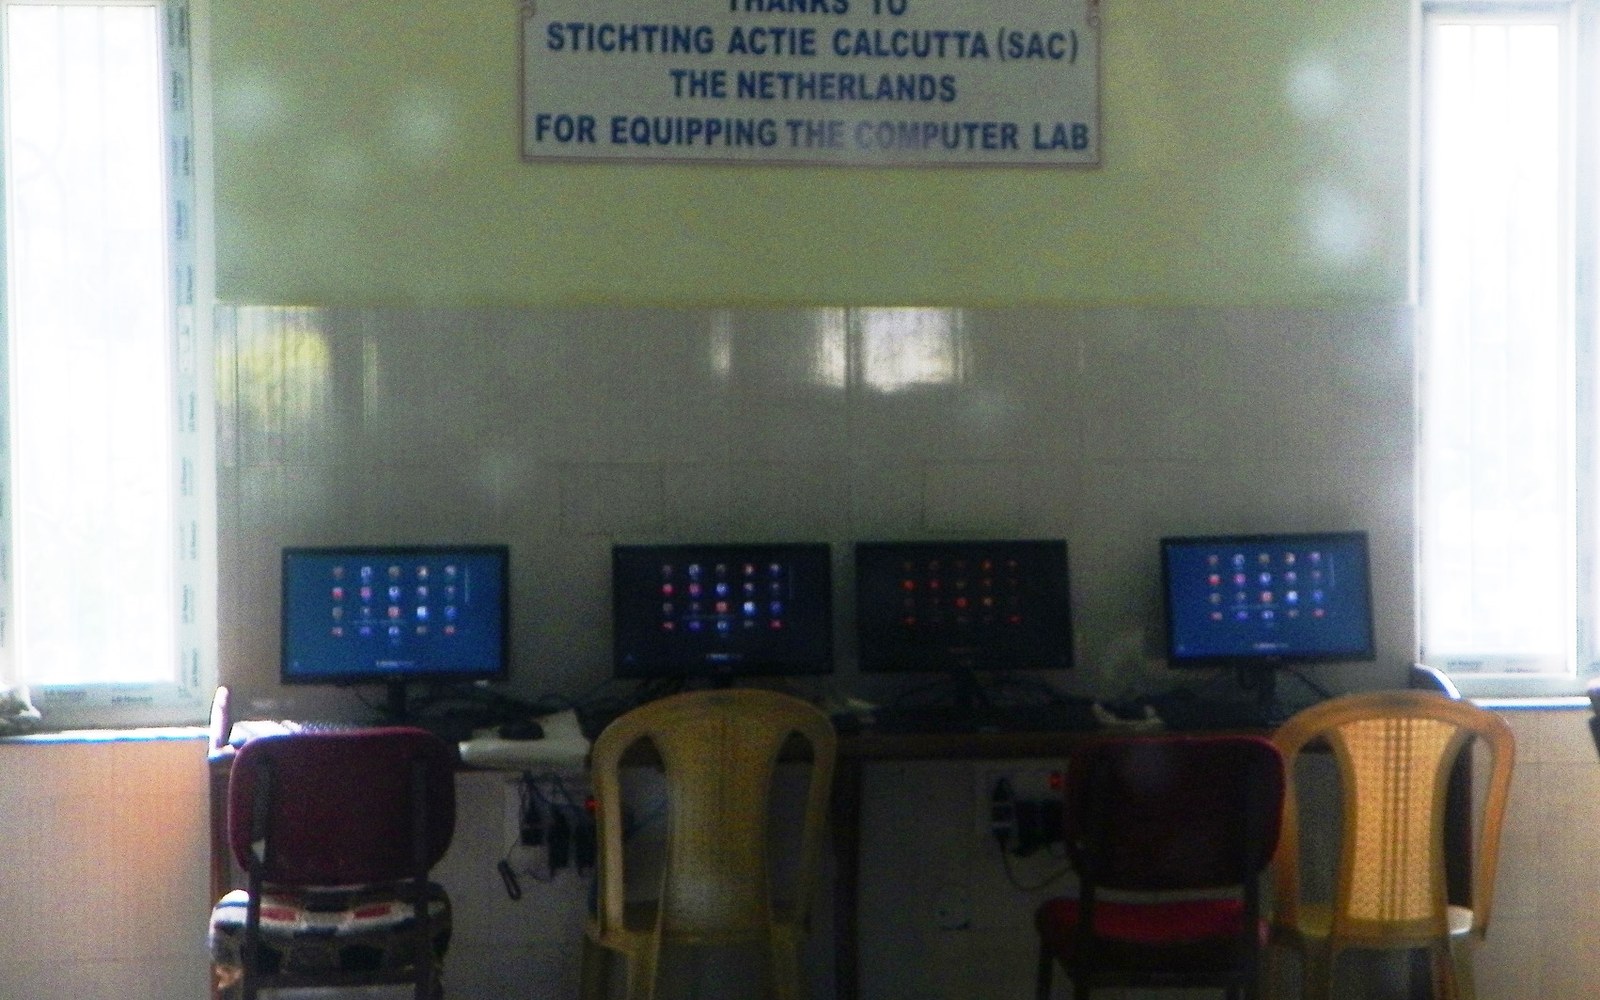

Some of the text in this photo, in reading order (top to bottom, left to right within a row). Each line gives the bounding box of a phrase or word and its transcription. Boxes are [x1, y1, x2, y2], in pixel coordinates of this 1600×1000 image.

[547, 21, 1079, 63] STICHTING ACTIE CALCUTTA (SAC)
[670, 68, 957, 102] THE NETHERLANDS
[535, 113, 1089, 150] FOR EQUIPPING THE COMPUTER LAB
